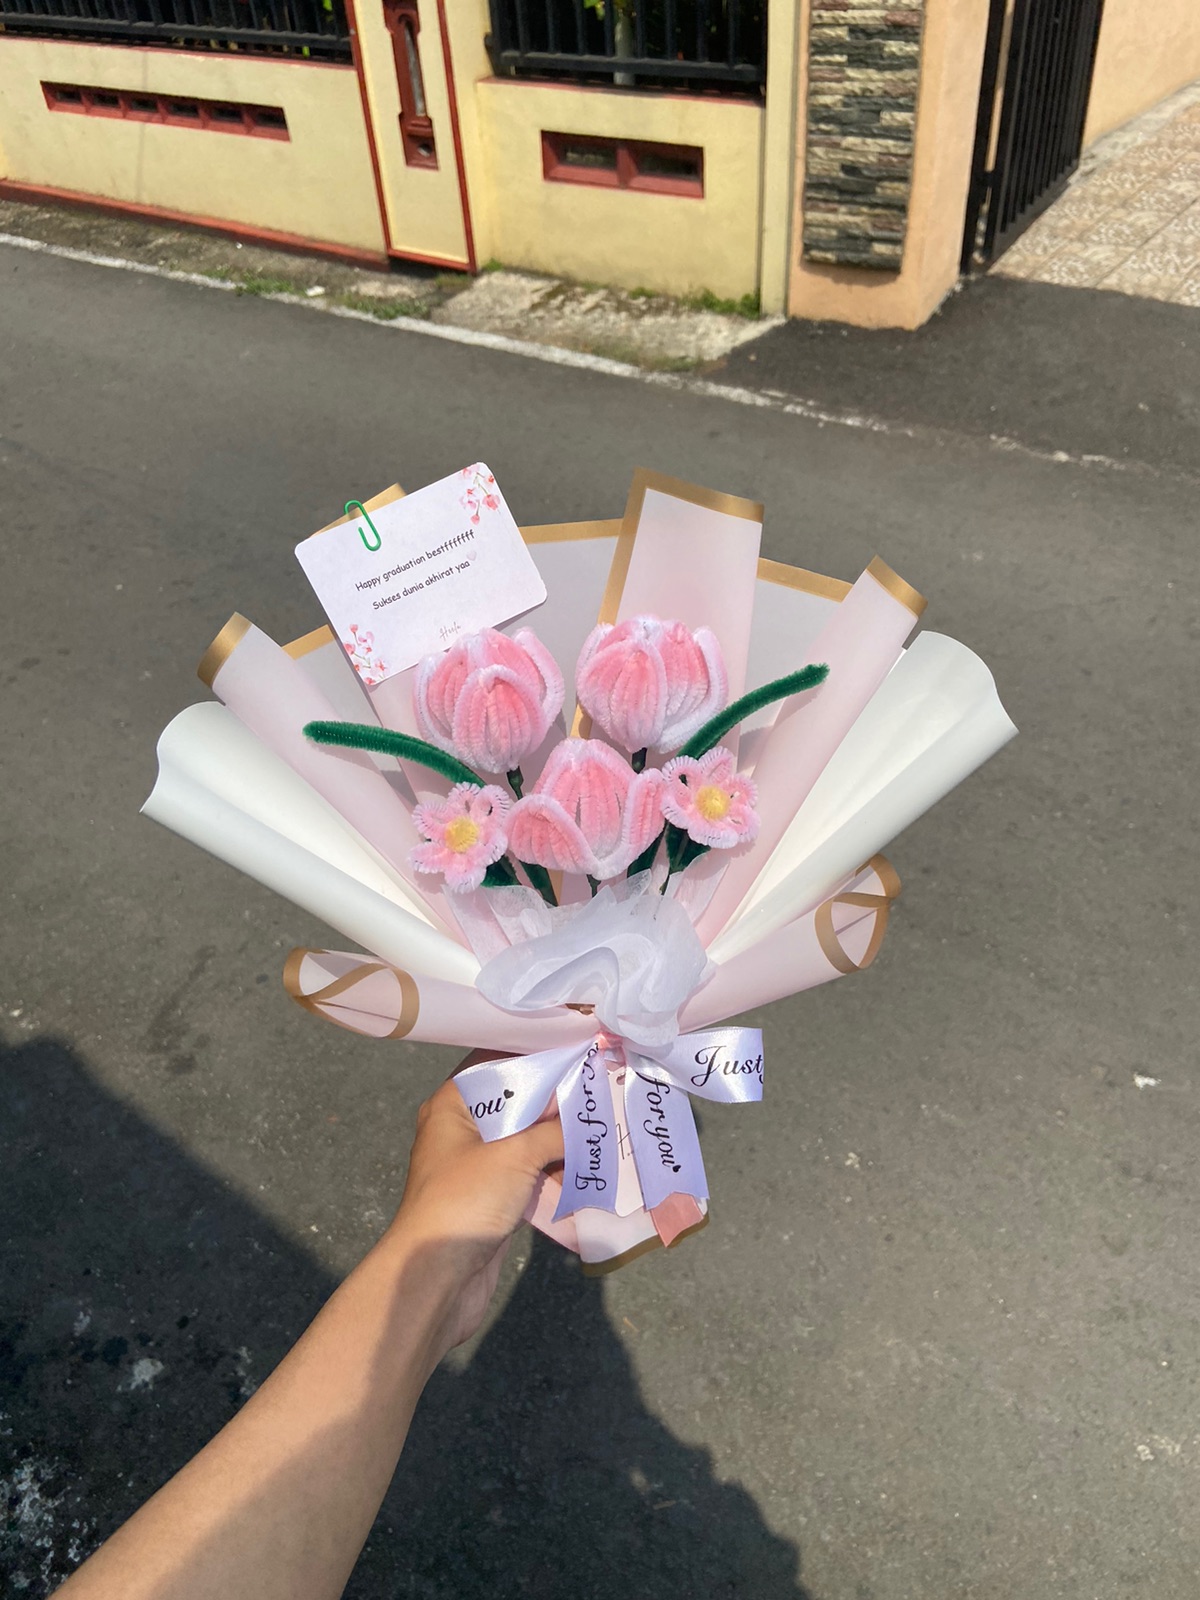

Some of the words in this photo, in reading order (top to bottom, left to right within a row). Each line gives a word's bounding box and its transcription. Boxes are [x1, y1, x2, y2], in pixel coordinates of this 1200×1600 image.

[355, 576, 381, 591] Happy
[383, 556, 426, 582] graduation
[373, 593, 401, 610] Sukses
[402, 583, 424, 597] dunia
[425, 567, 454, 586] akhirat
[455, 561, 470, 573] yaa
[690, 1045, 763, 1087] Just
[577, 1080, 608, 1138] for
[635, 1071, 671, 1122] for
[575, 1134, 607, 1191] Just
[643, 1119, 675, 1168] you
